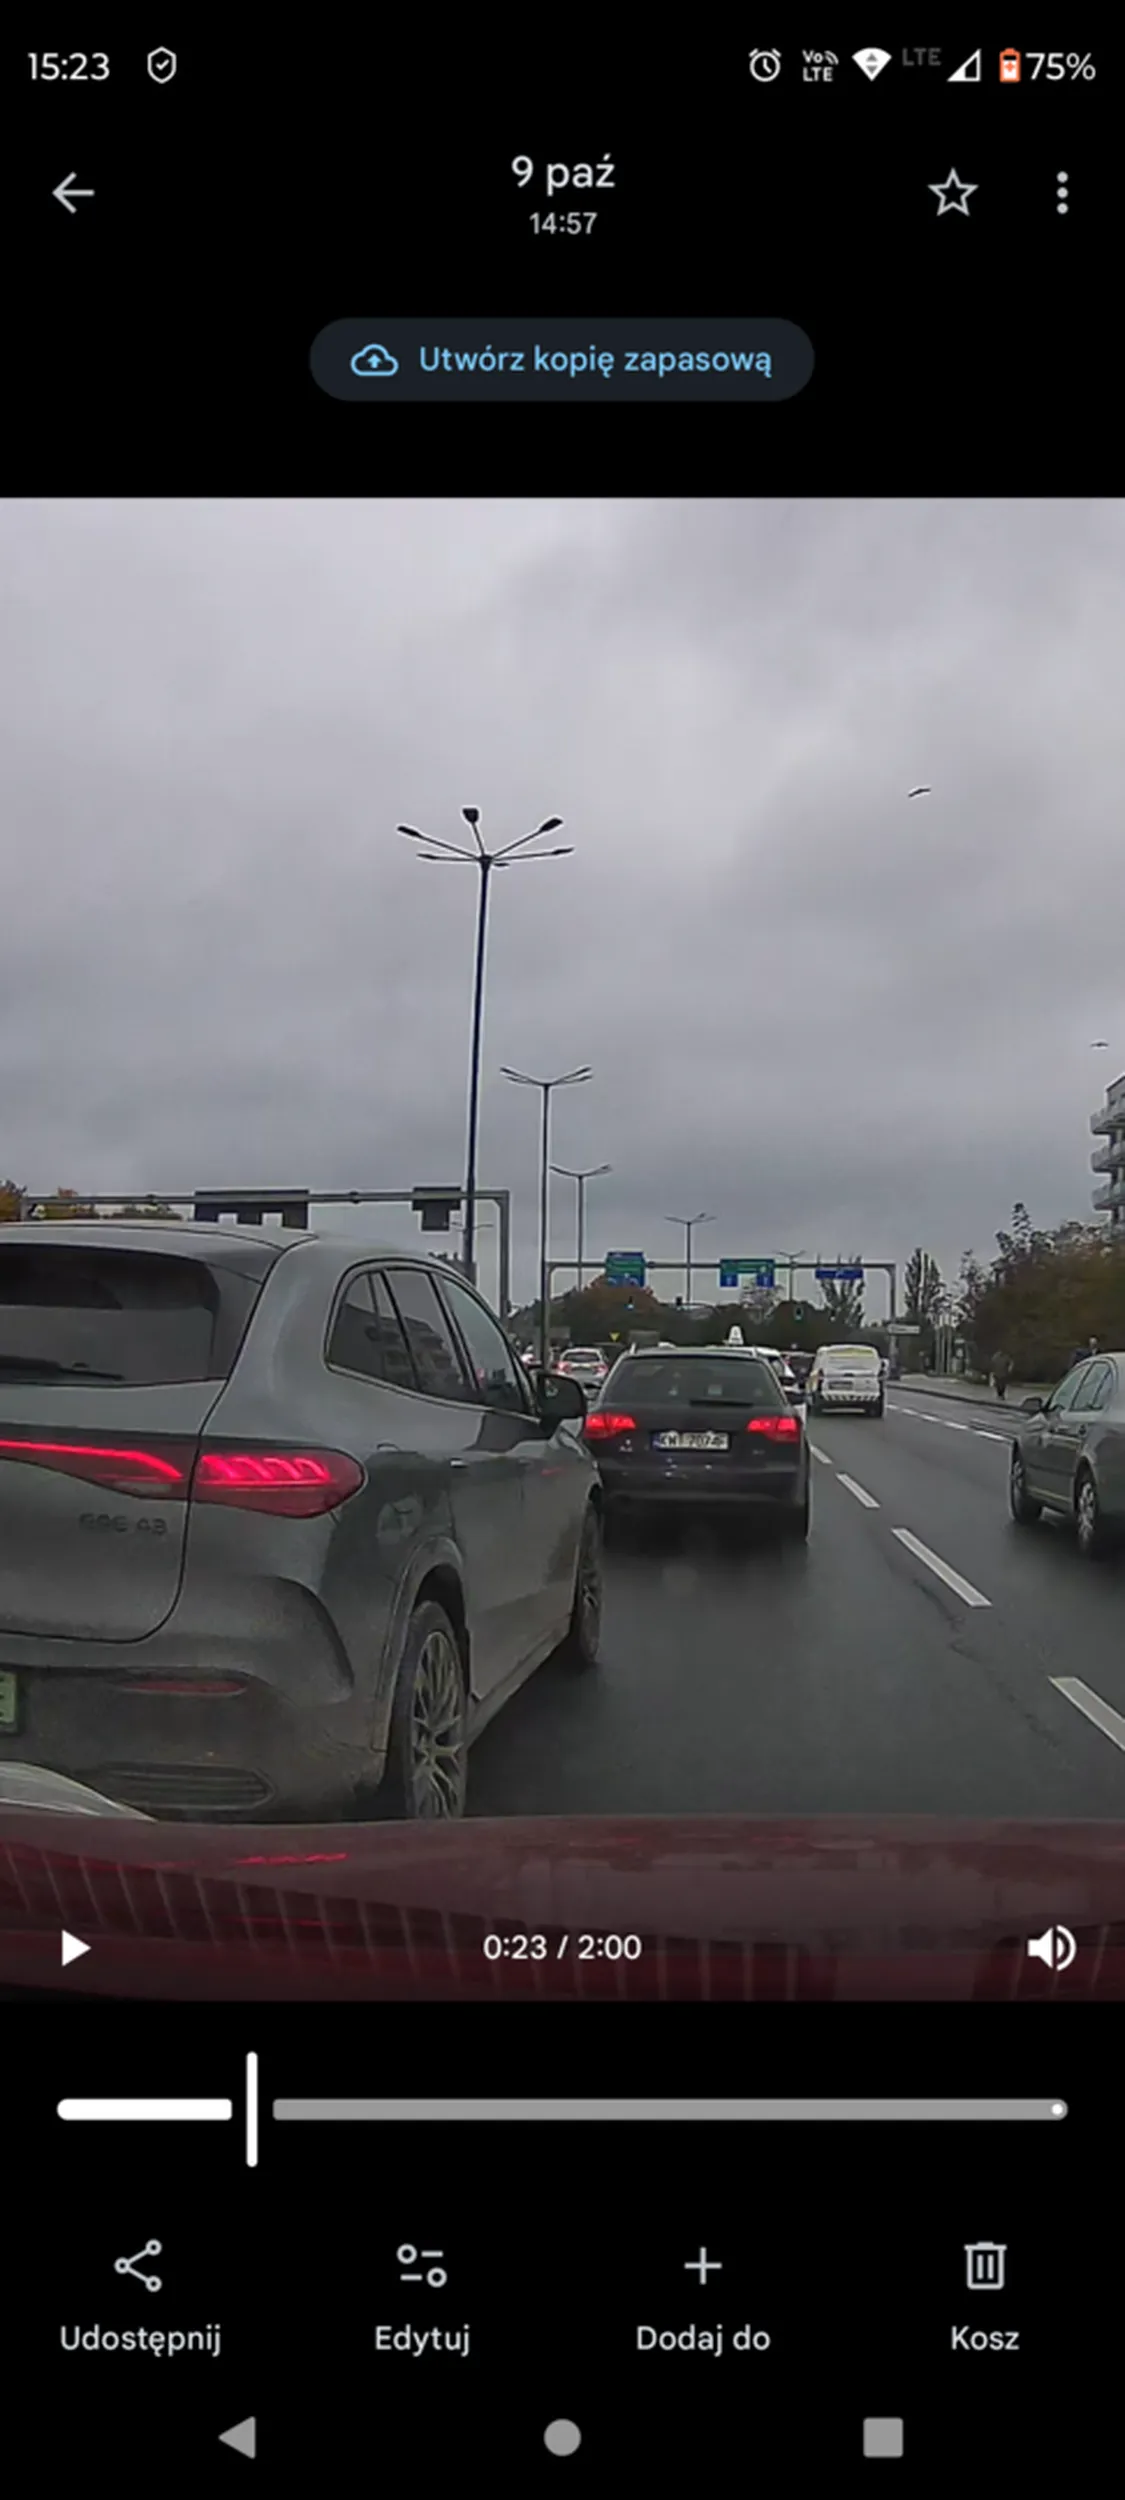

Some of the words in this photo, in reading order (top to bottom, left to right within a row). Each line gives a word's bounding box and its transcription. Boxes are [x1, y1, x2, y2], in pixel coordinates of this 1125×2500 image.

[27, 52, 110, 81] 15:23
[802, 50, 822, 65] Vo
[902, 47, 941, 66] LTE
[1025, 52, 1096, 81] 75%
[802, 66, 833, 82] LTE
[511, 155, 534, 188] 9
[546, 153, 615, 197] paź
[530, 211, 598, 235] 14:57
[420, 344, 525, 372] Utwórz
[534, 344, 615, 379] kopię
[624, 351, 772, 378] zapasową
[483, 1934, 547, 1960] 0:23
[557, 1935, 568, 1959] /
[578, 1934, 641, 1960] 2:00
[60, 2323, 221, 2358] Udostępnij
[375, 2323, 470, 2357] Edytuj
[637, 2323, 723, 2358] Dodaj
[732, 2323, 771, 2351] do
[951, 2325, 1020, 2351] Kosz
